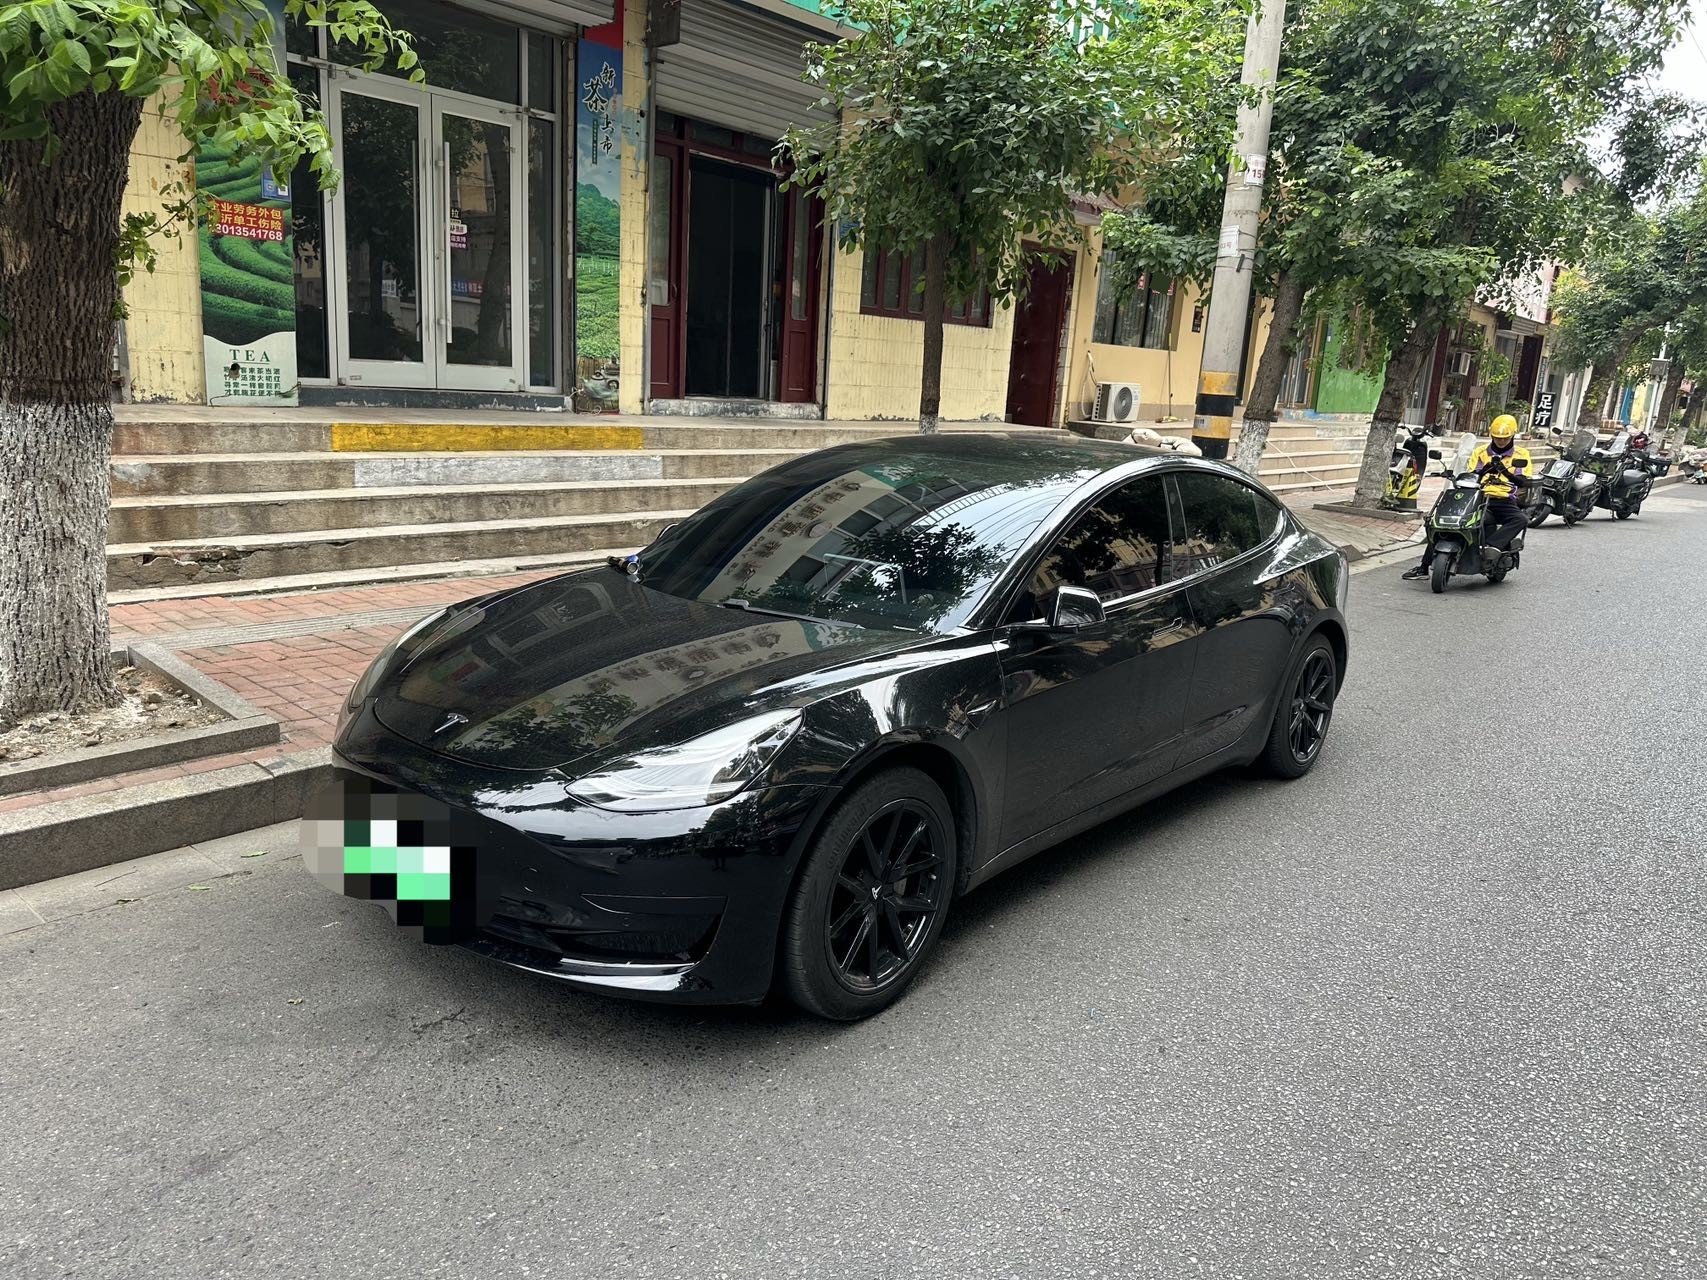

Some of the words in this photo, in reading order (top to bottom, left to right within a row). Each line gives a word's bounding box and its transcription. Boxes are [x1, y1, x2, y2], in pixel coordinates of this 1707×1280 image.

[583, 61, 616, 156] 新茶上市
[209, 213, 282, 231] 沂单工伤险
[209, 223, 283, 241] 3013541768
[229, 349, 271, 362] TEA
[1535, 394, 1552, 425] 足疗
